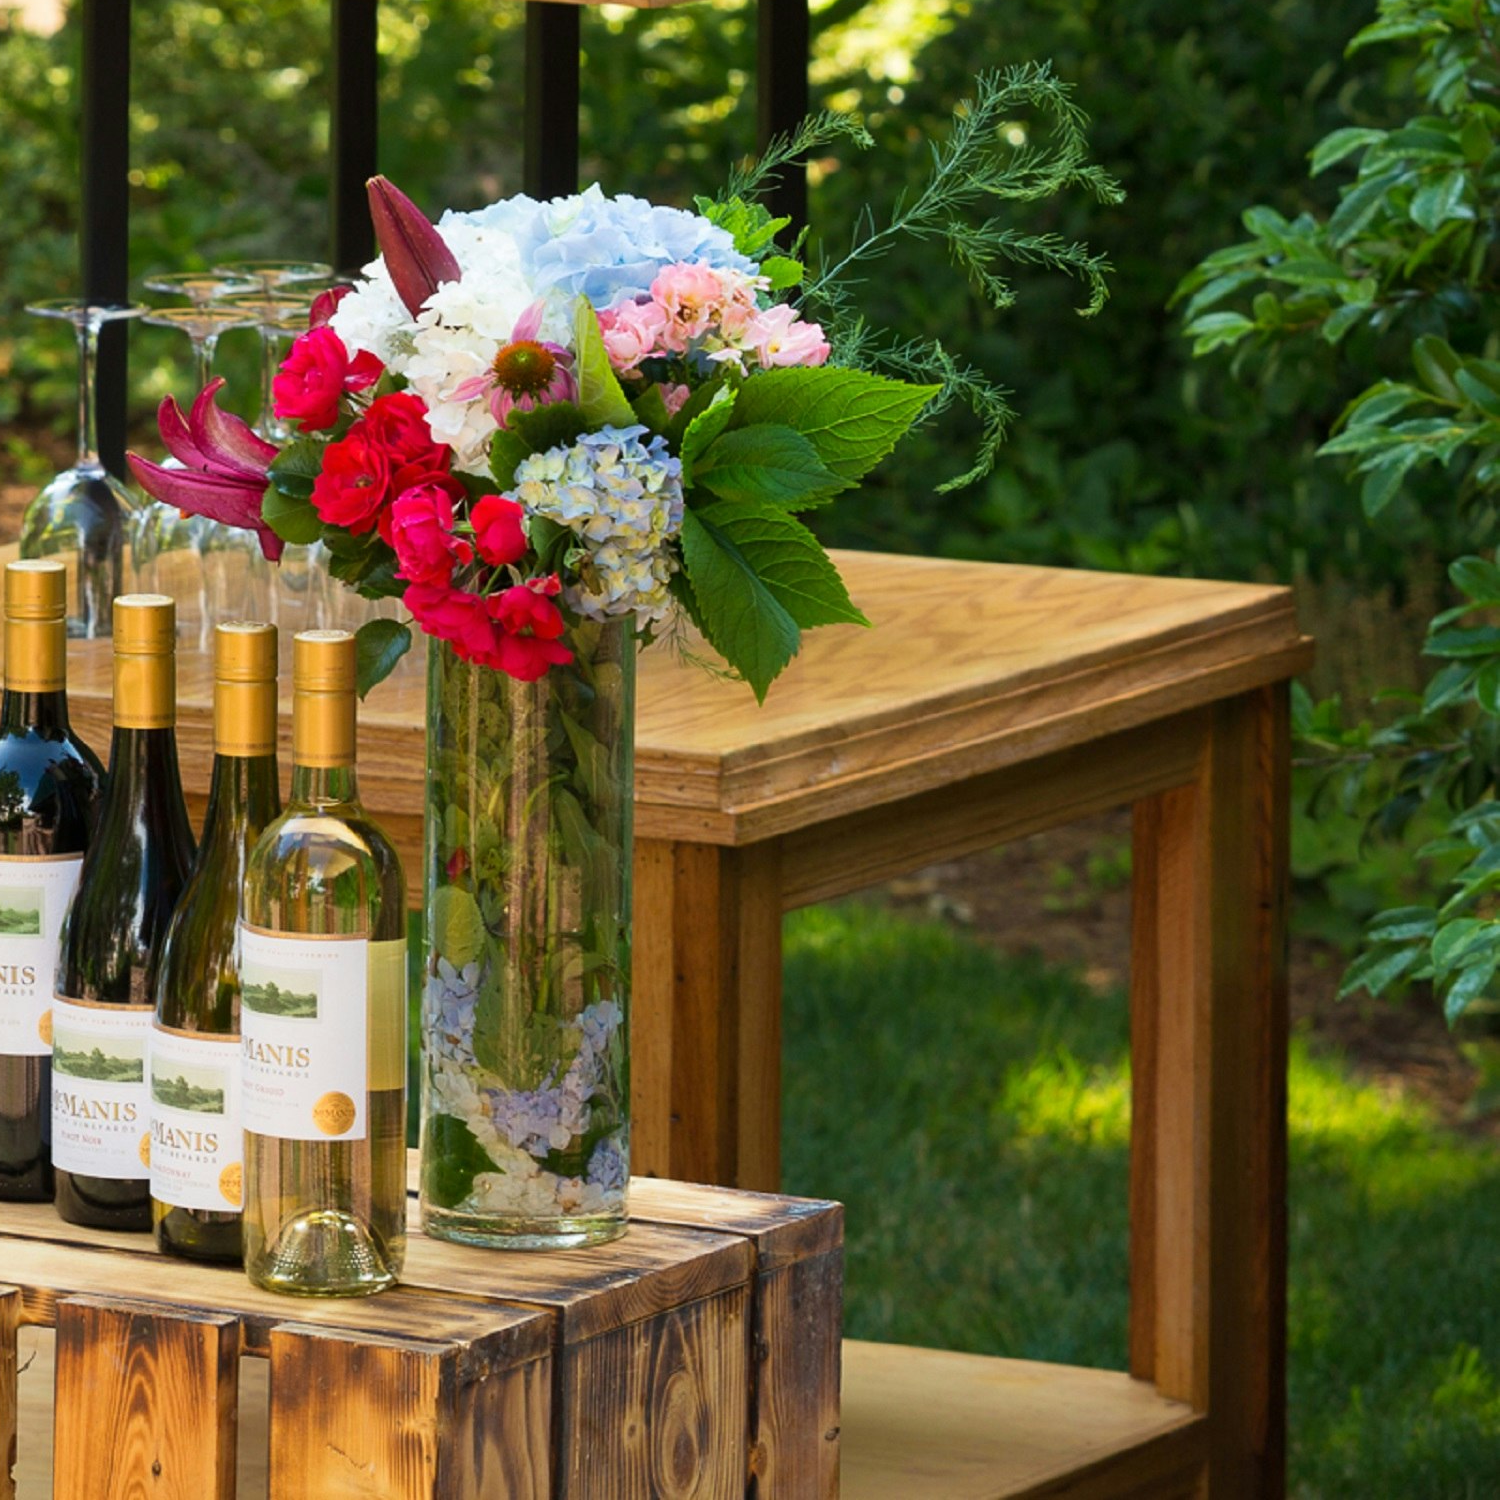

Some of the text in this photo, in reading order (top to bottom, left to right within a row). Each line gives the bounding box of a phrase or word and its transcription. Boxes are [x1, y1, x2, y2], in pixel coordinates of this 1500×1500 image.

[243, 1035, 310, 1068] MANIS
[55, 1091, 136, 1122] MANIS
[151, 1118, 218, 1153] MANIS
